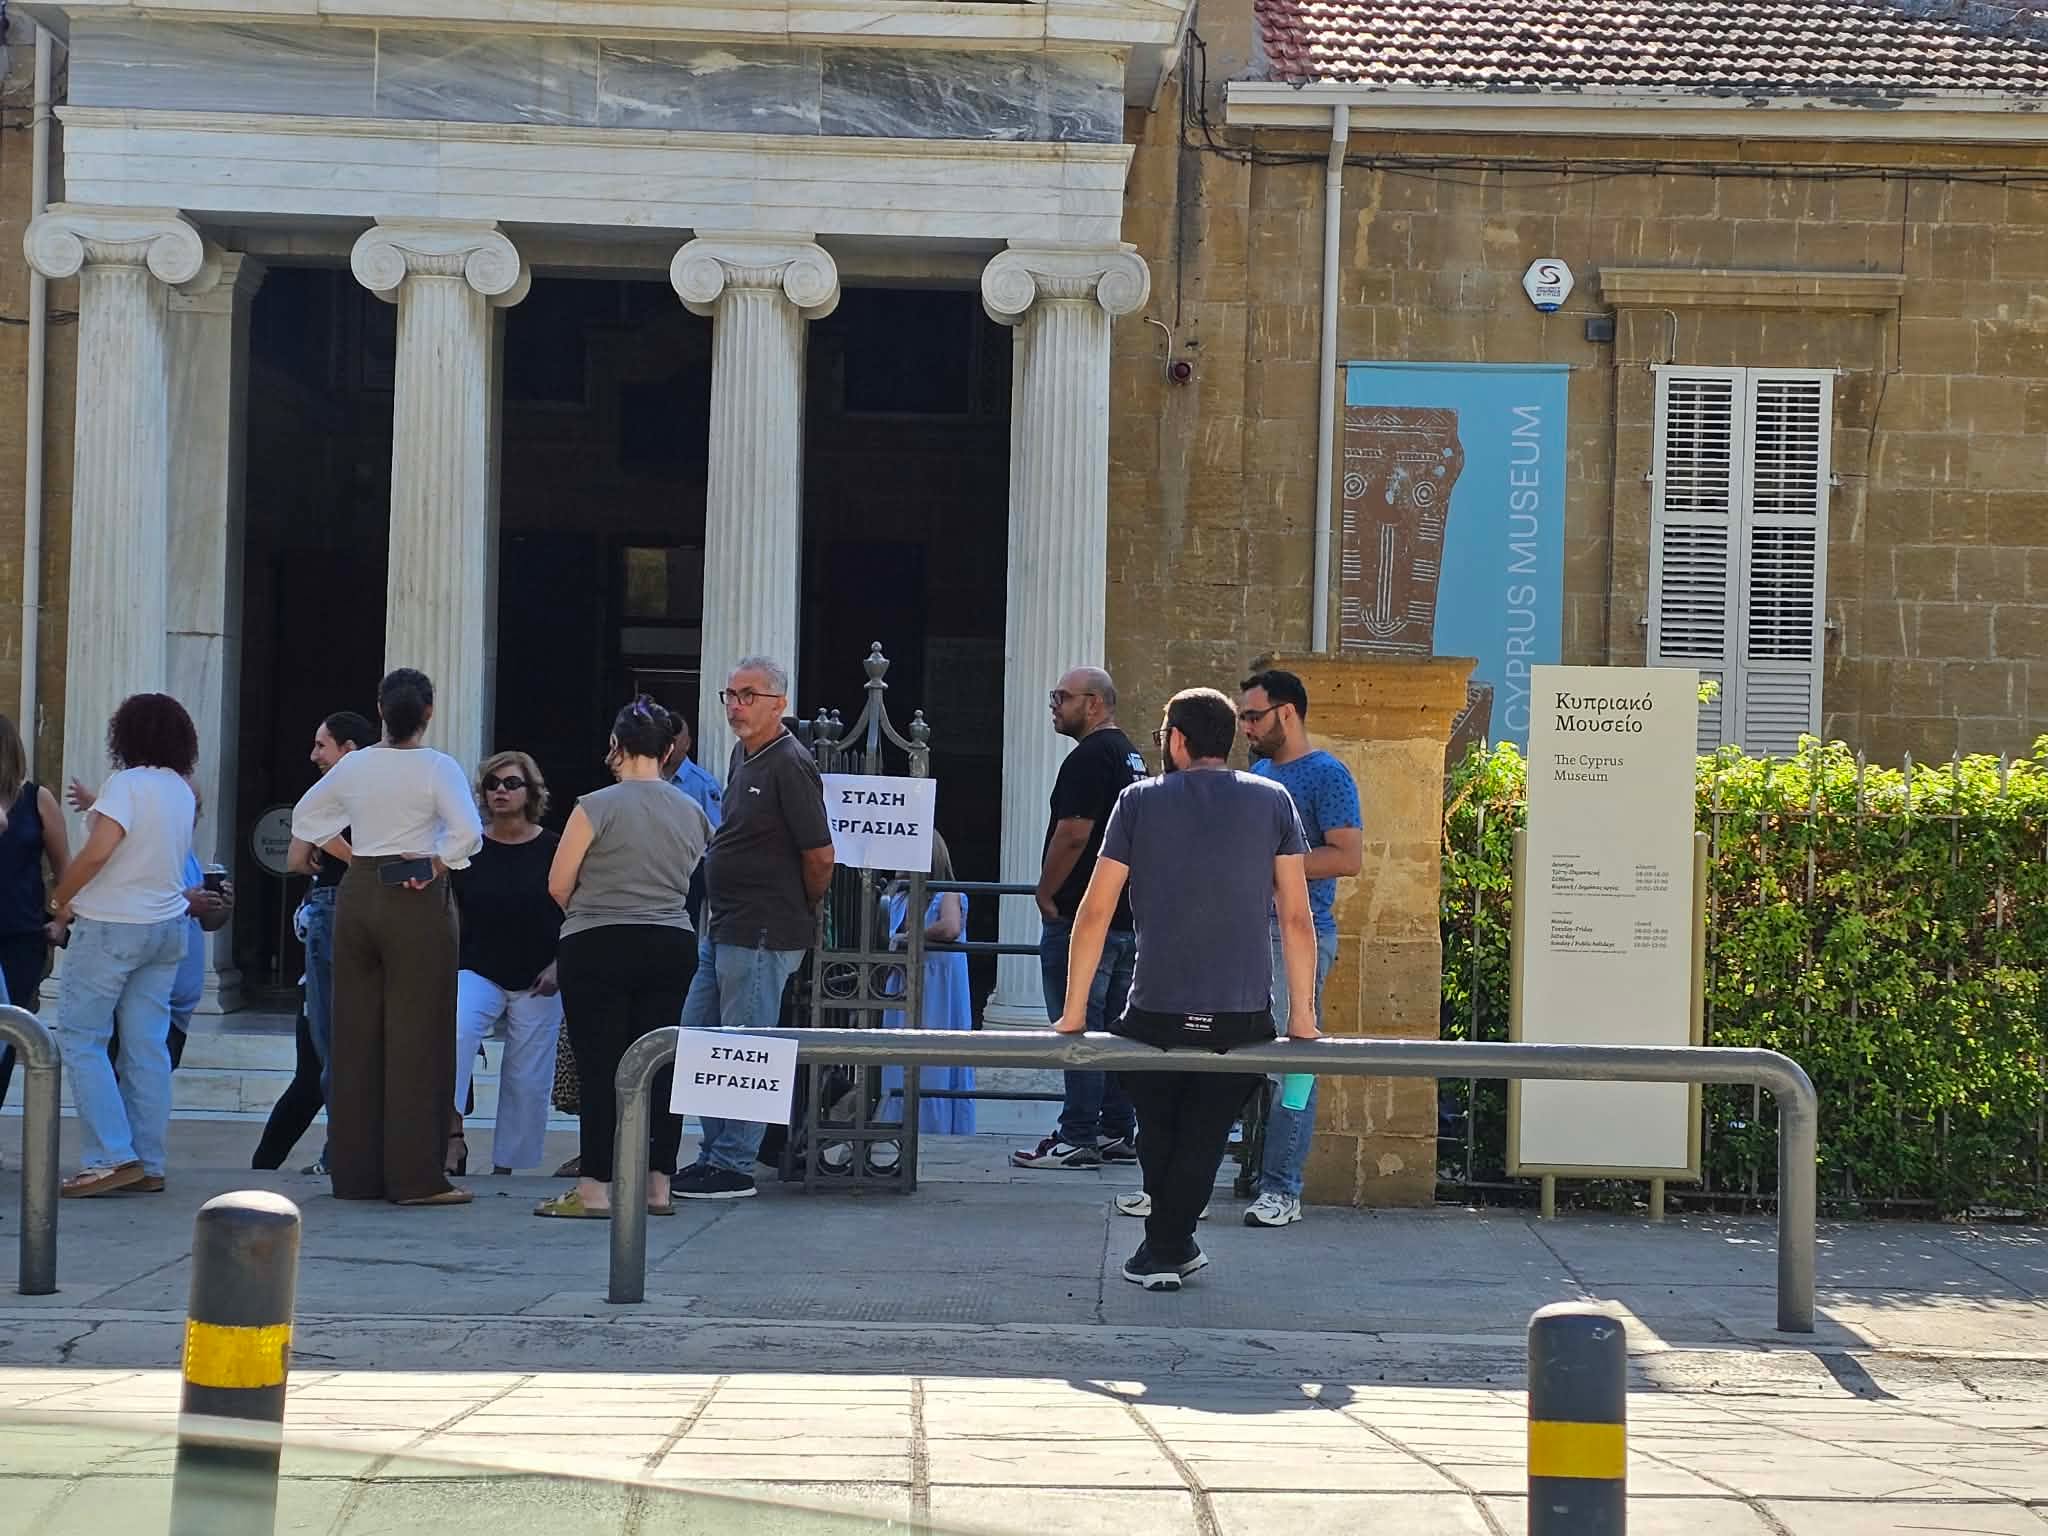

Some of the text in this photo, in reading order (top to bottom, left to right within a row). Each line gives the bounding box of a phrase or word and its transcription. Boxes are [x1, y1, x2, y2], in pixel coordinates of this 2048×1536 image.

[1504, 405, 1542, 731] CYPRUS MUSEUM
[1555, 692, 1653, 715] Κυπριακό
[1555, 714, 1643, 733] Μουσείο
[1554, 754, 1624, 769] The Cyprus
[1554, 769, 1608, 782] Museum
[841, 790, 905, 806] ΣΤΑΣΗ
[711, 1047, 769, 1064] ΣΤΑΣΗ
[694, 1072, 780, 1092] ΕΡΓΑΣΙΑΣ
